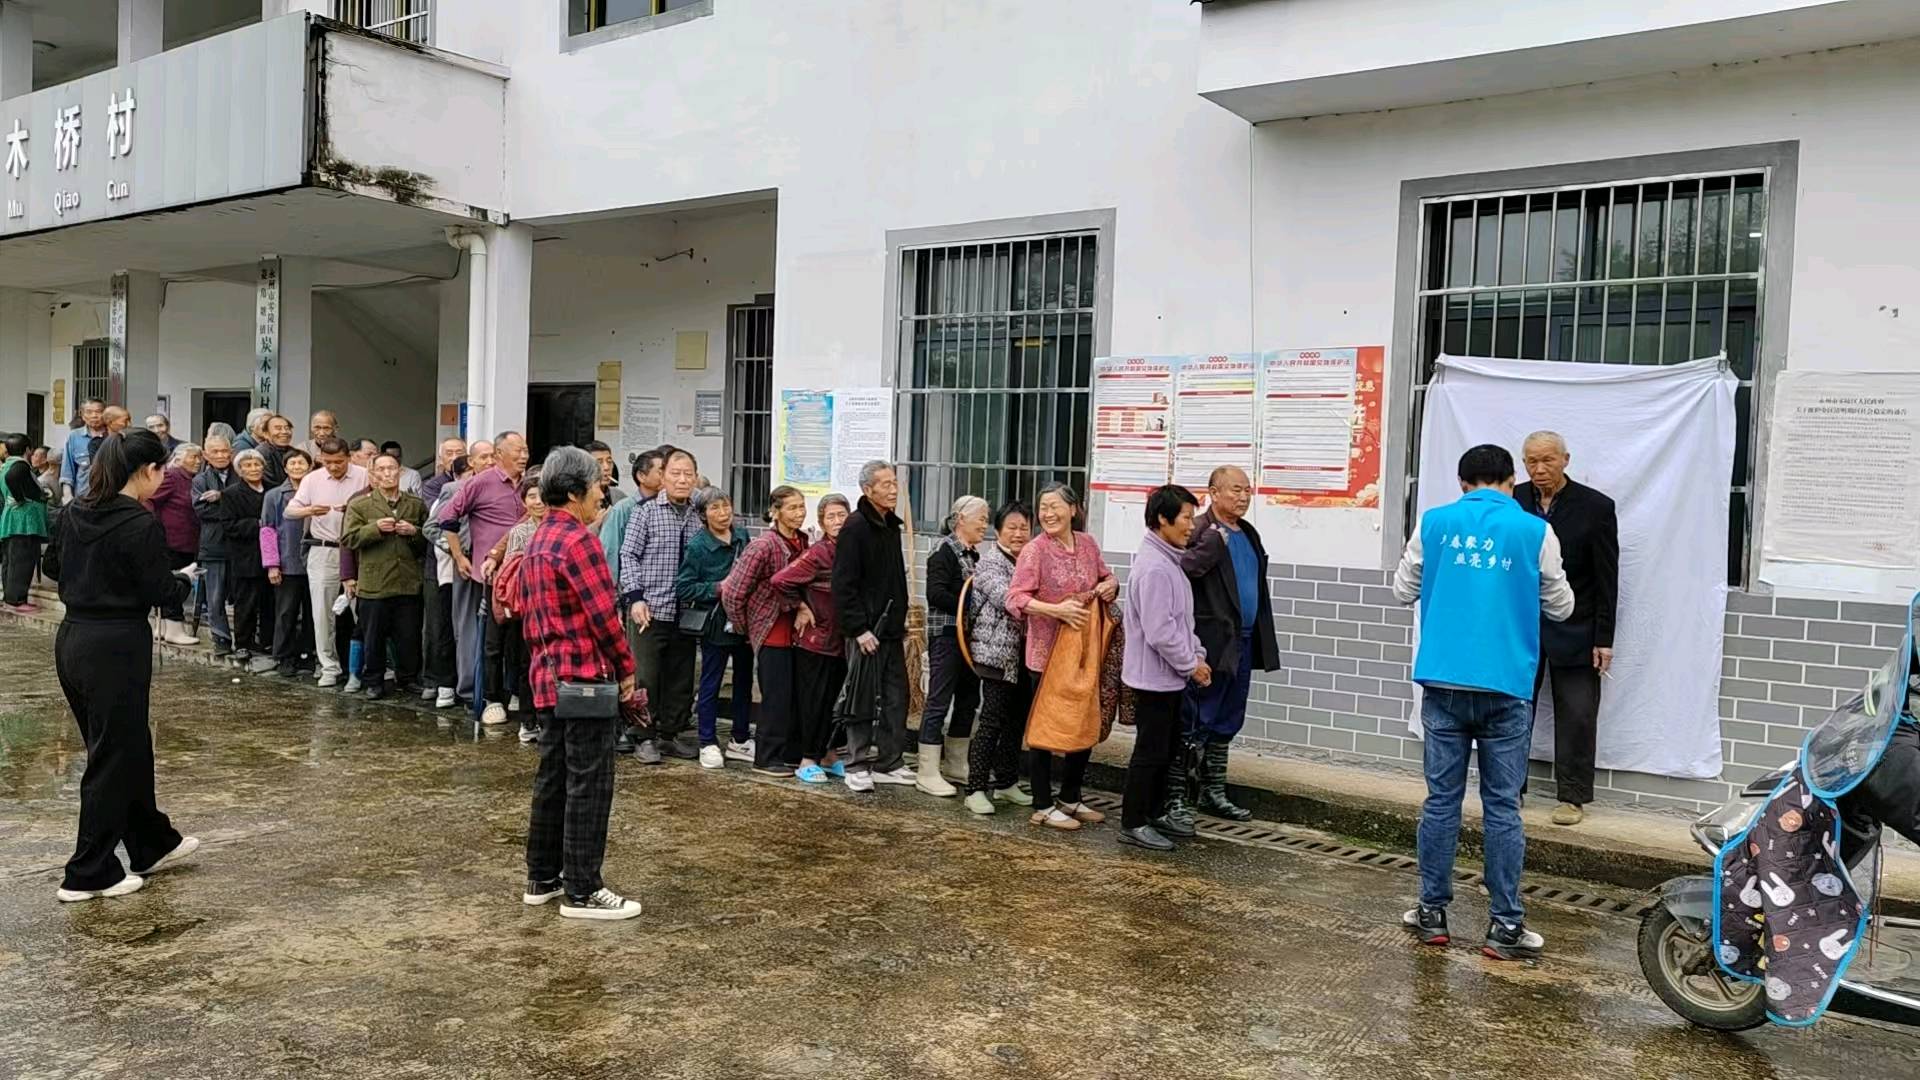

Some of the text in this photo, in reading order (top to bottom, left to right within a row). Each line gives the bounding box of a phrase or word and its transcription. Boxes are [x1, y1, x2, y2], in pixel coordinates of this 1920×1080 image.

[5, 87, 137, 180] 木桥村
[8, 180, 130, 218] Mu Qiao Cun
[1440, 534, 1495, 551] 春聚力
